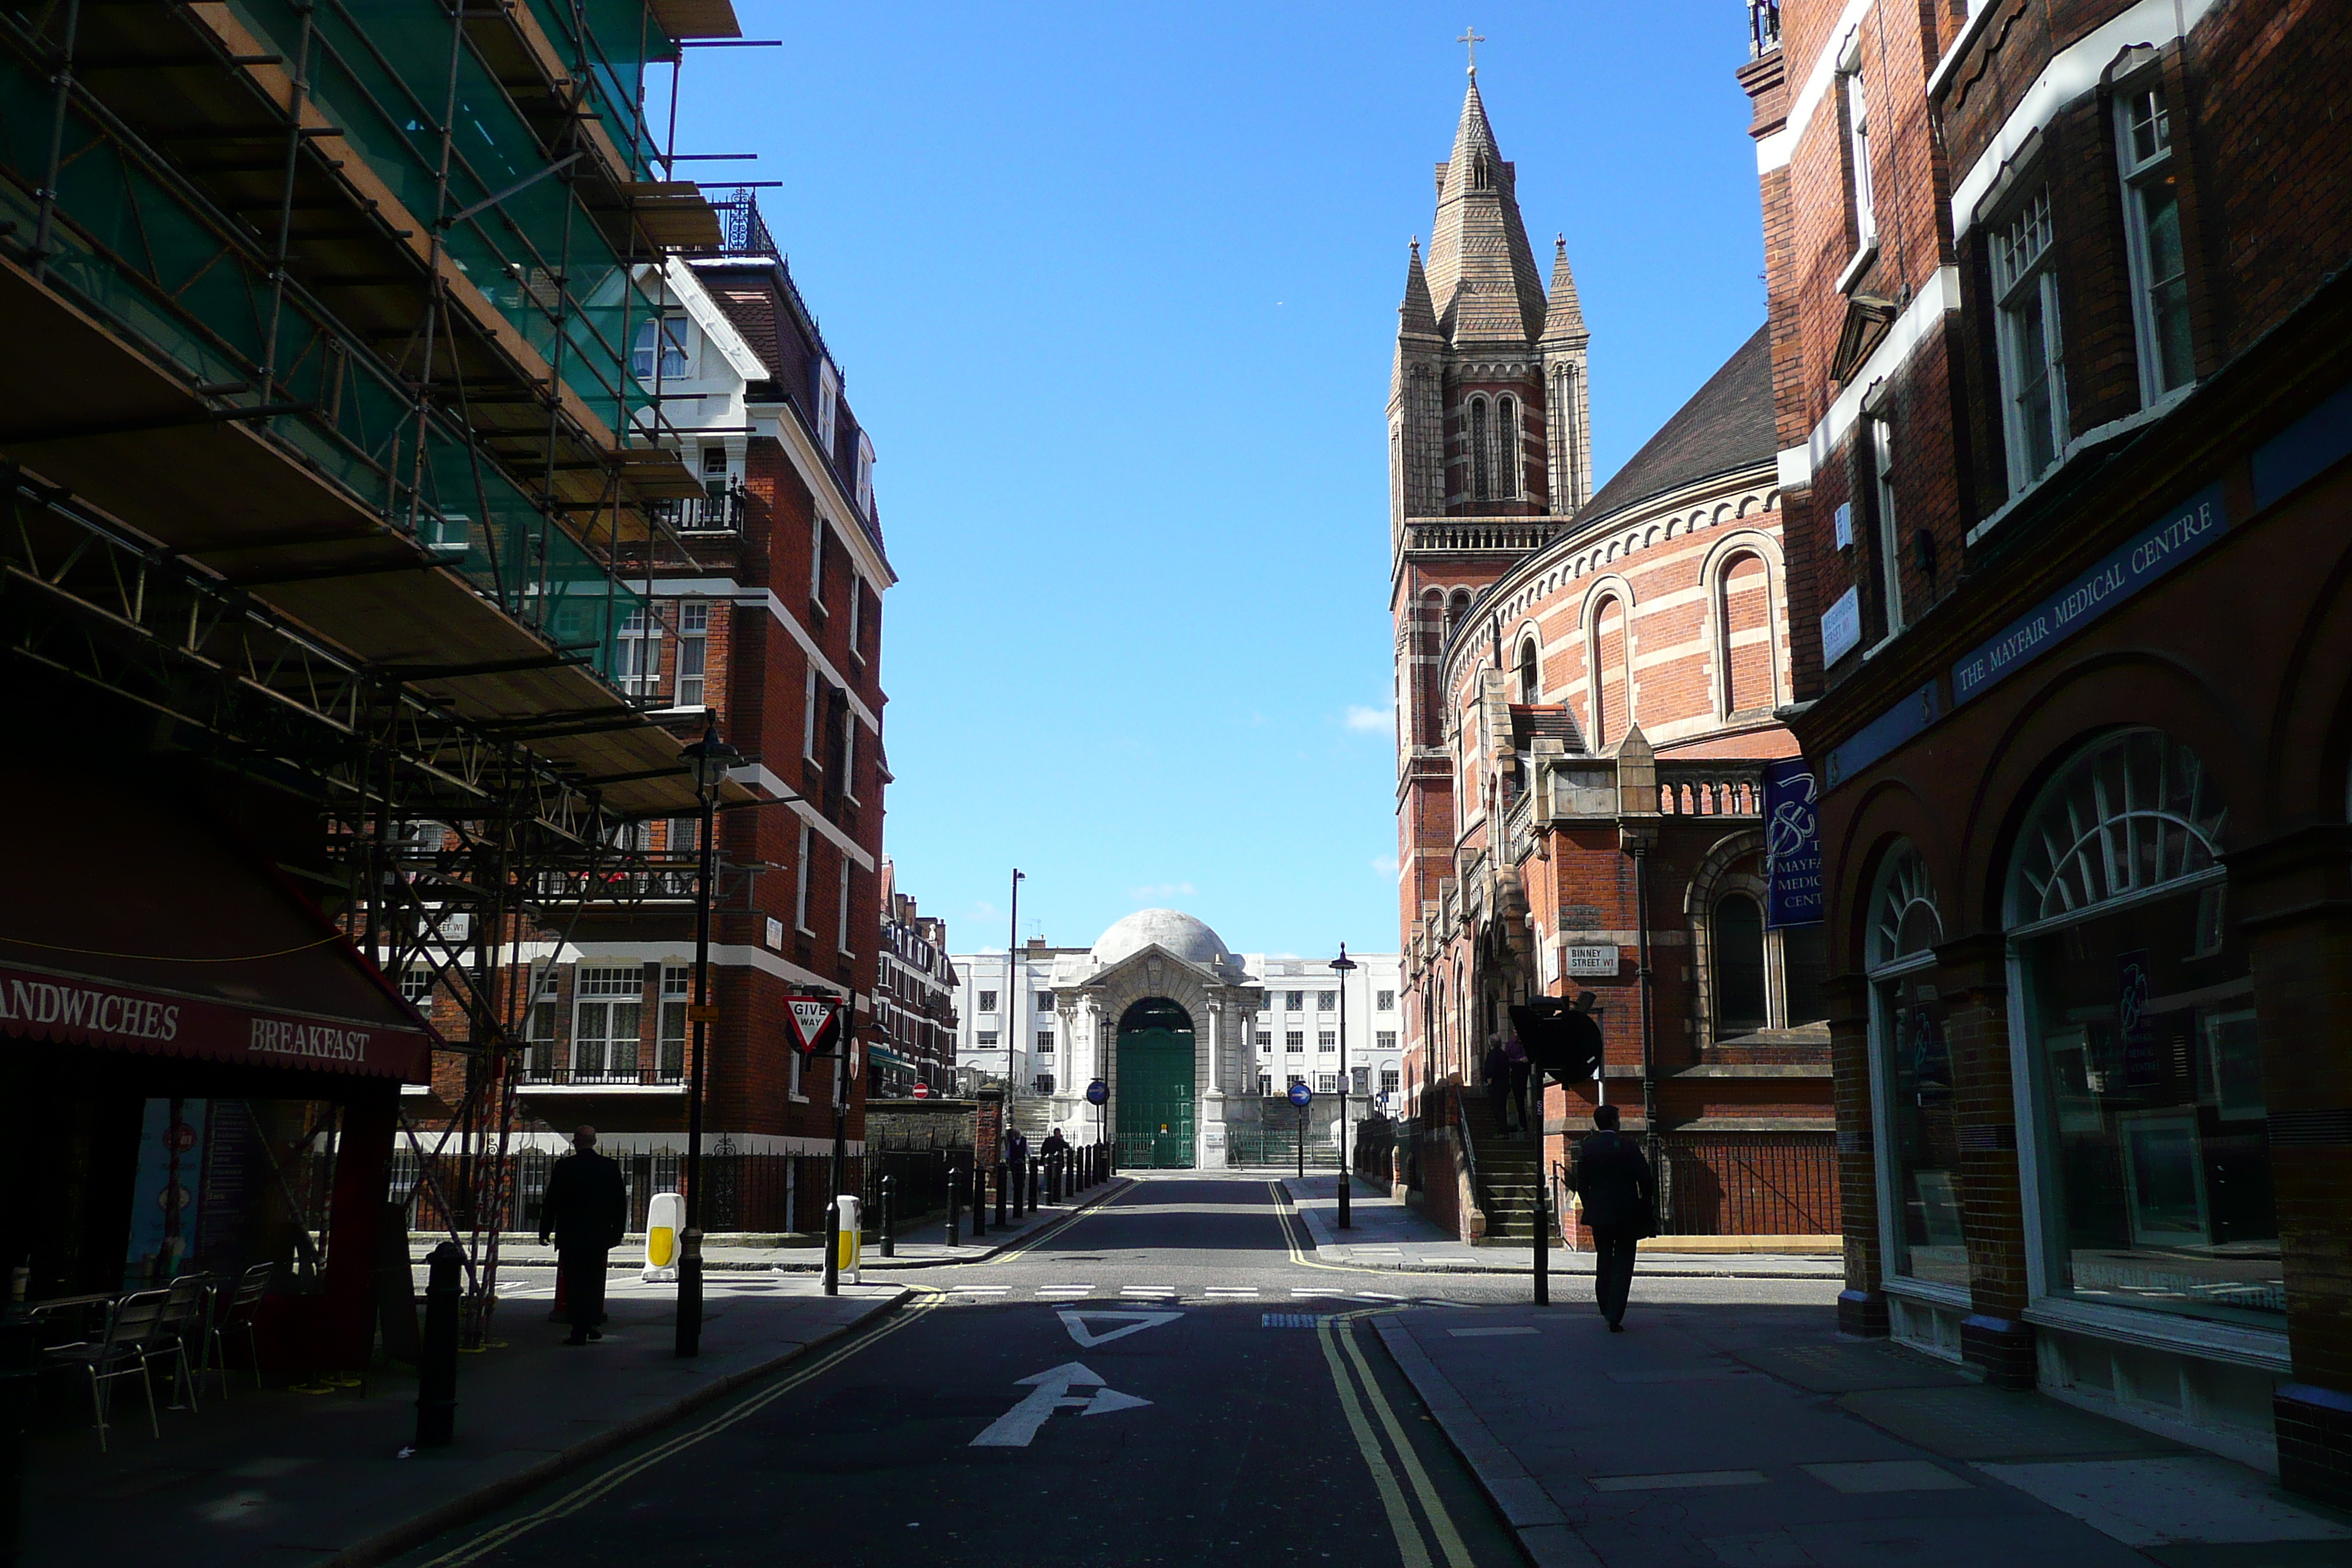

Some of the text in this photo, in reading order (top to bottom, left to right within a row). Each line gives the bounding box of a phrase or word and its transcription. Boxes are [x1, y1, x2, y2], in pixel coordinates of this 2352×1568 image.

[1959, 502, 2212, 690] THE MAYFAIR MEDICAL CENTRE
[1572, 949, 1601, 957] BINNEY
[1572, 958, 1613, 967] STREET W1
[794, 1003, 826, 1016] GIVE
[801, 1018, 821, 1027] WAY
[249, 1017, 370, 1062] BREAKFAST
